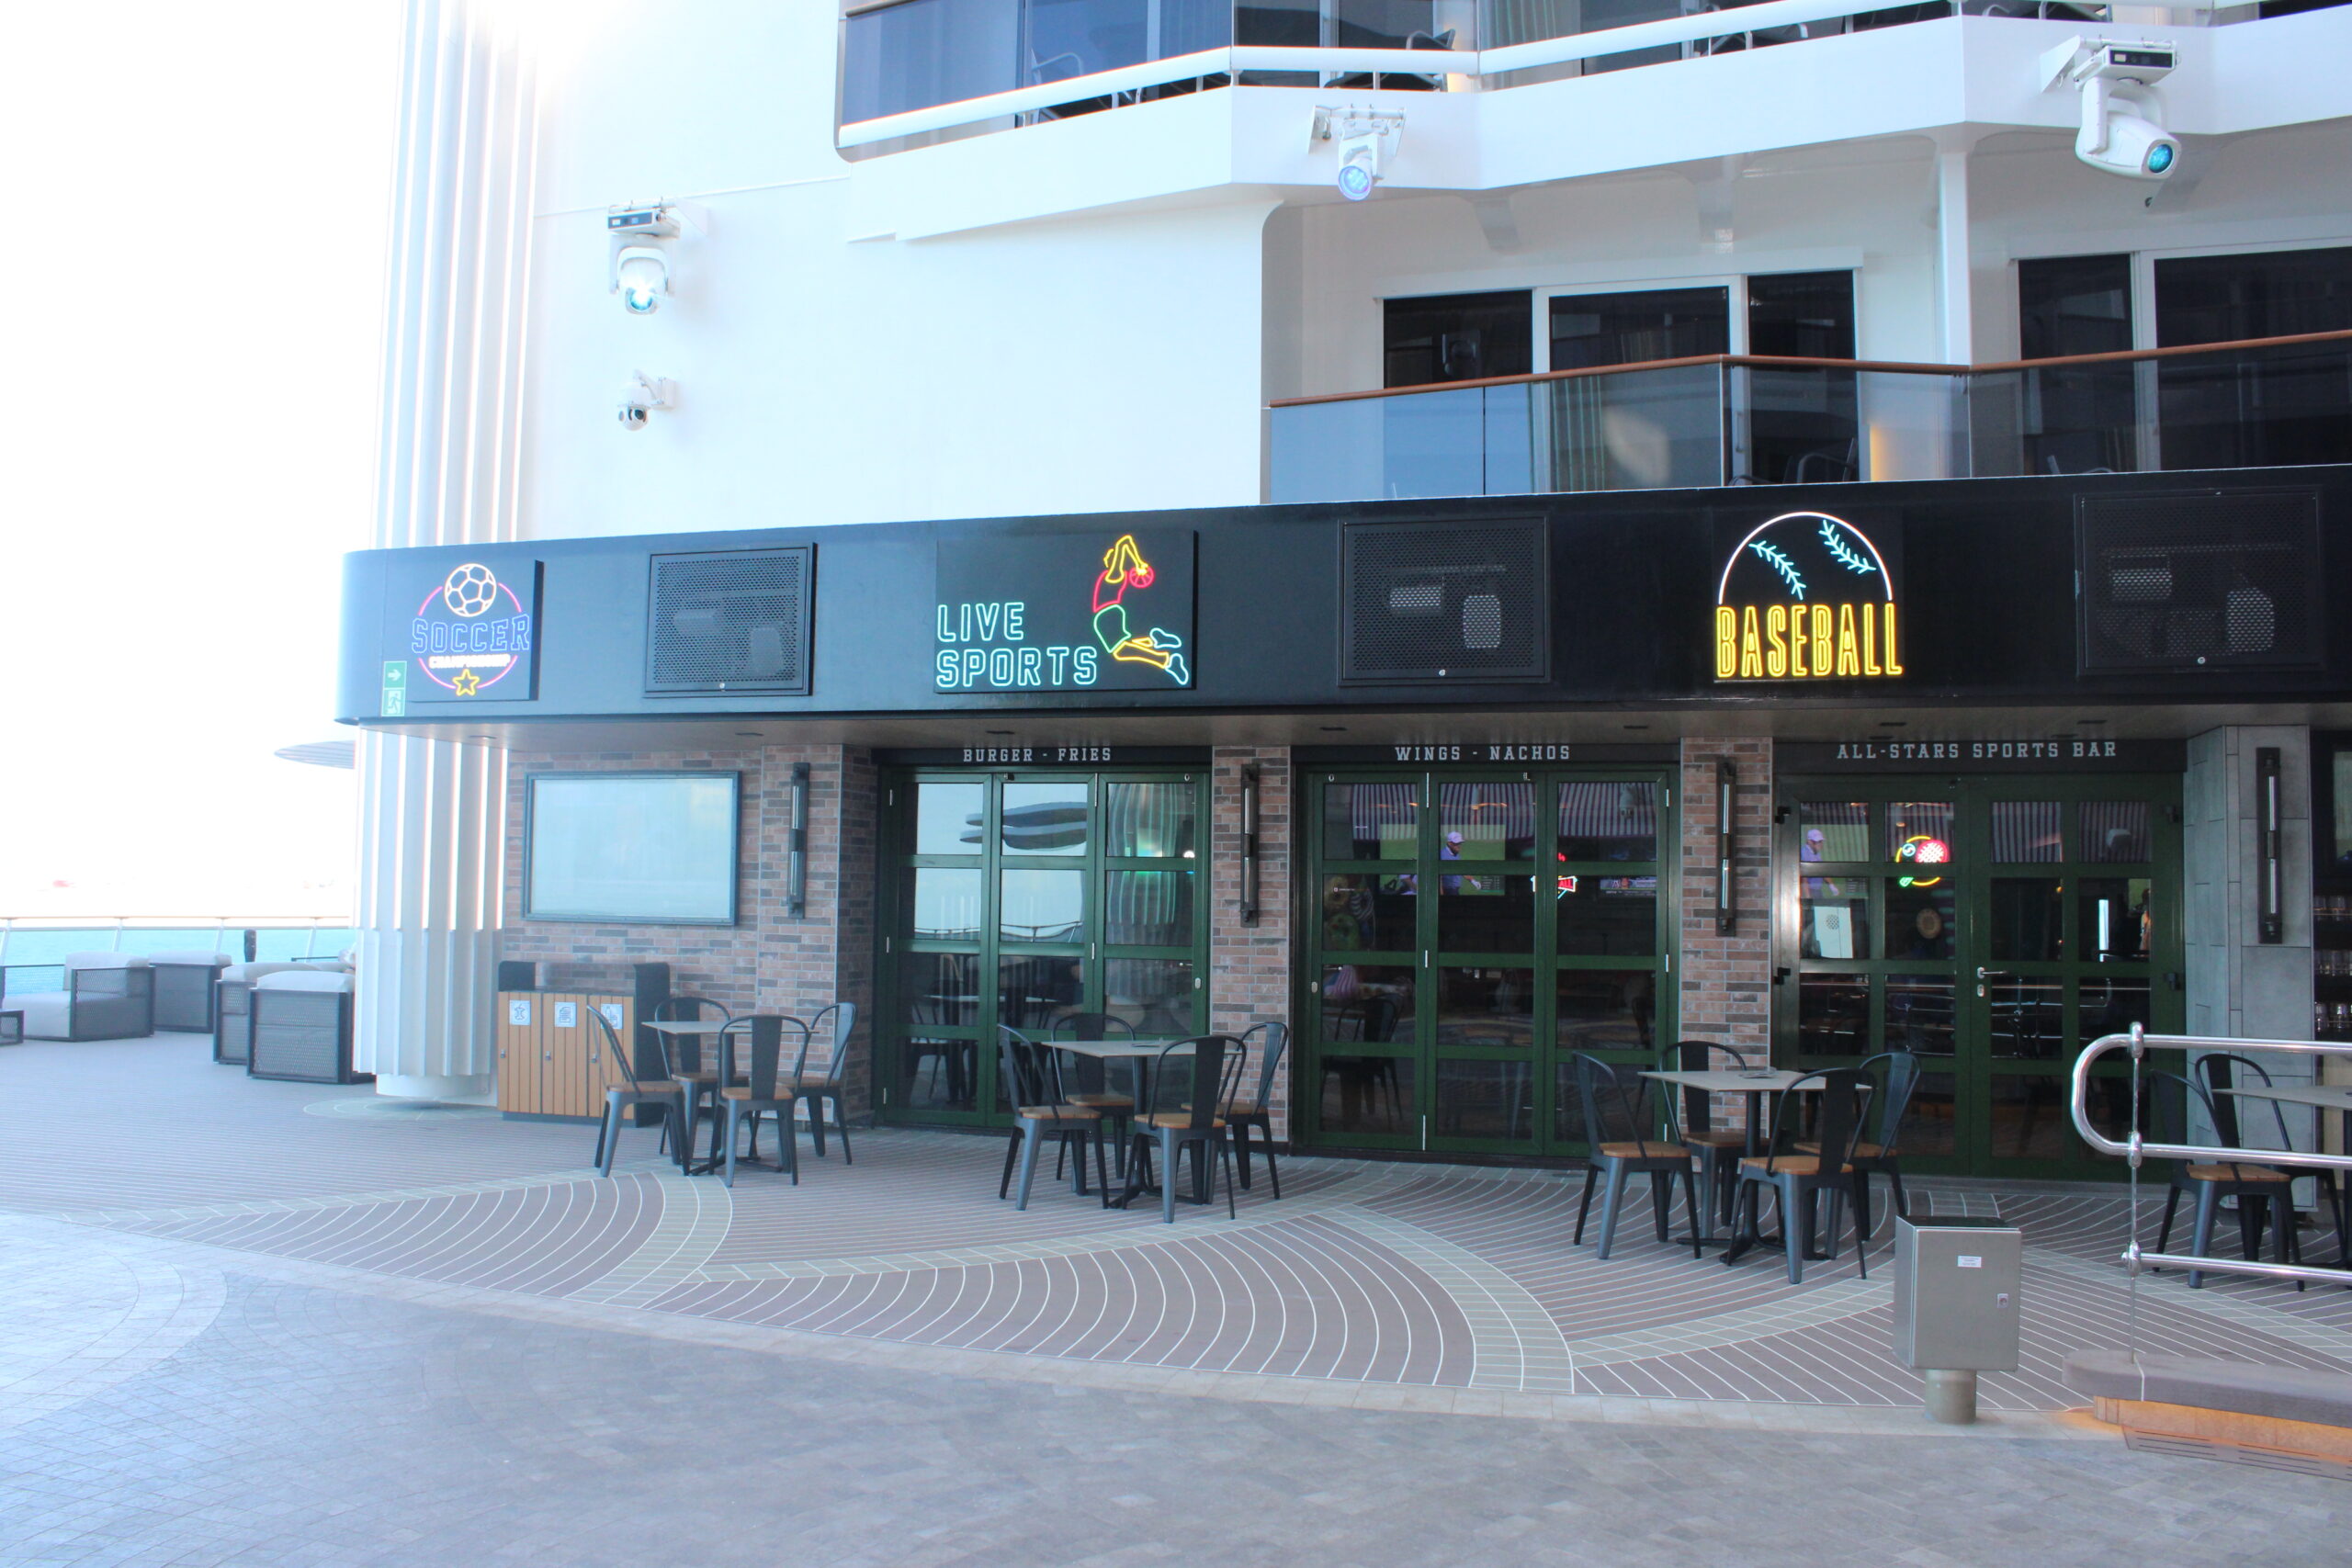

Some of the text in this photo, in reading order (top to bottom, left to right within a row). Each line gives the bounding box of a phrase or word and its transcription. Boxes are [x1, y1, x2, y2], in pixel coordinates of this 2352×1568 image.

[412, 614, 530, 654] SOCCER
[937, 602, 1024, 642] LIVE
[1716, 603, 1903, 678] BASEBALL
[936, 646, 1097, 688] SPORTS
[963, 748, 1034, 762] BURGER
[1057, 747, 1111, 761] FRIES
[1395, 746, 1461, 761] WINGS
[1489, 745, 1570, 761] NACHOS
[1837, 741, 2117, 759] ALL-STARS SPORTS BAR
